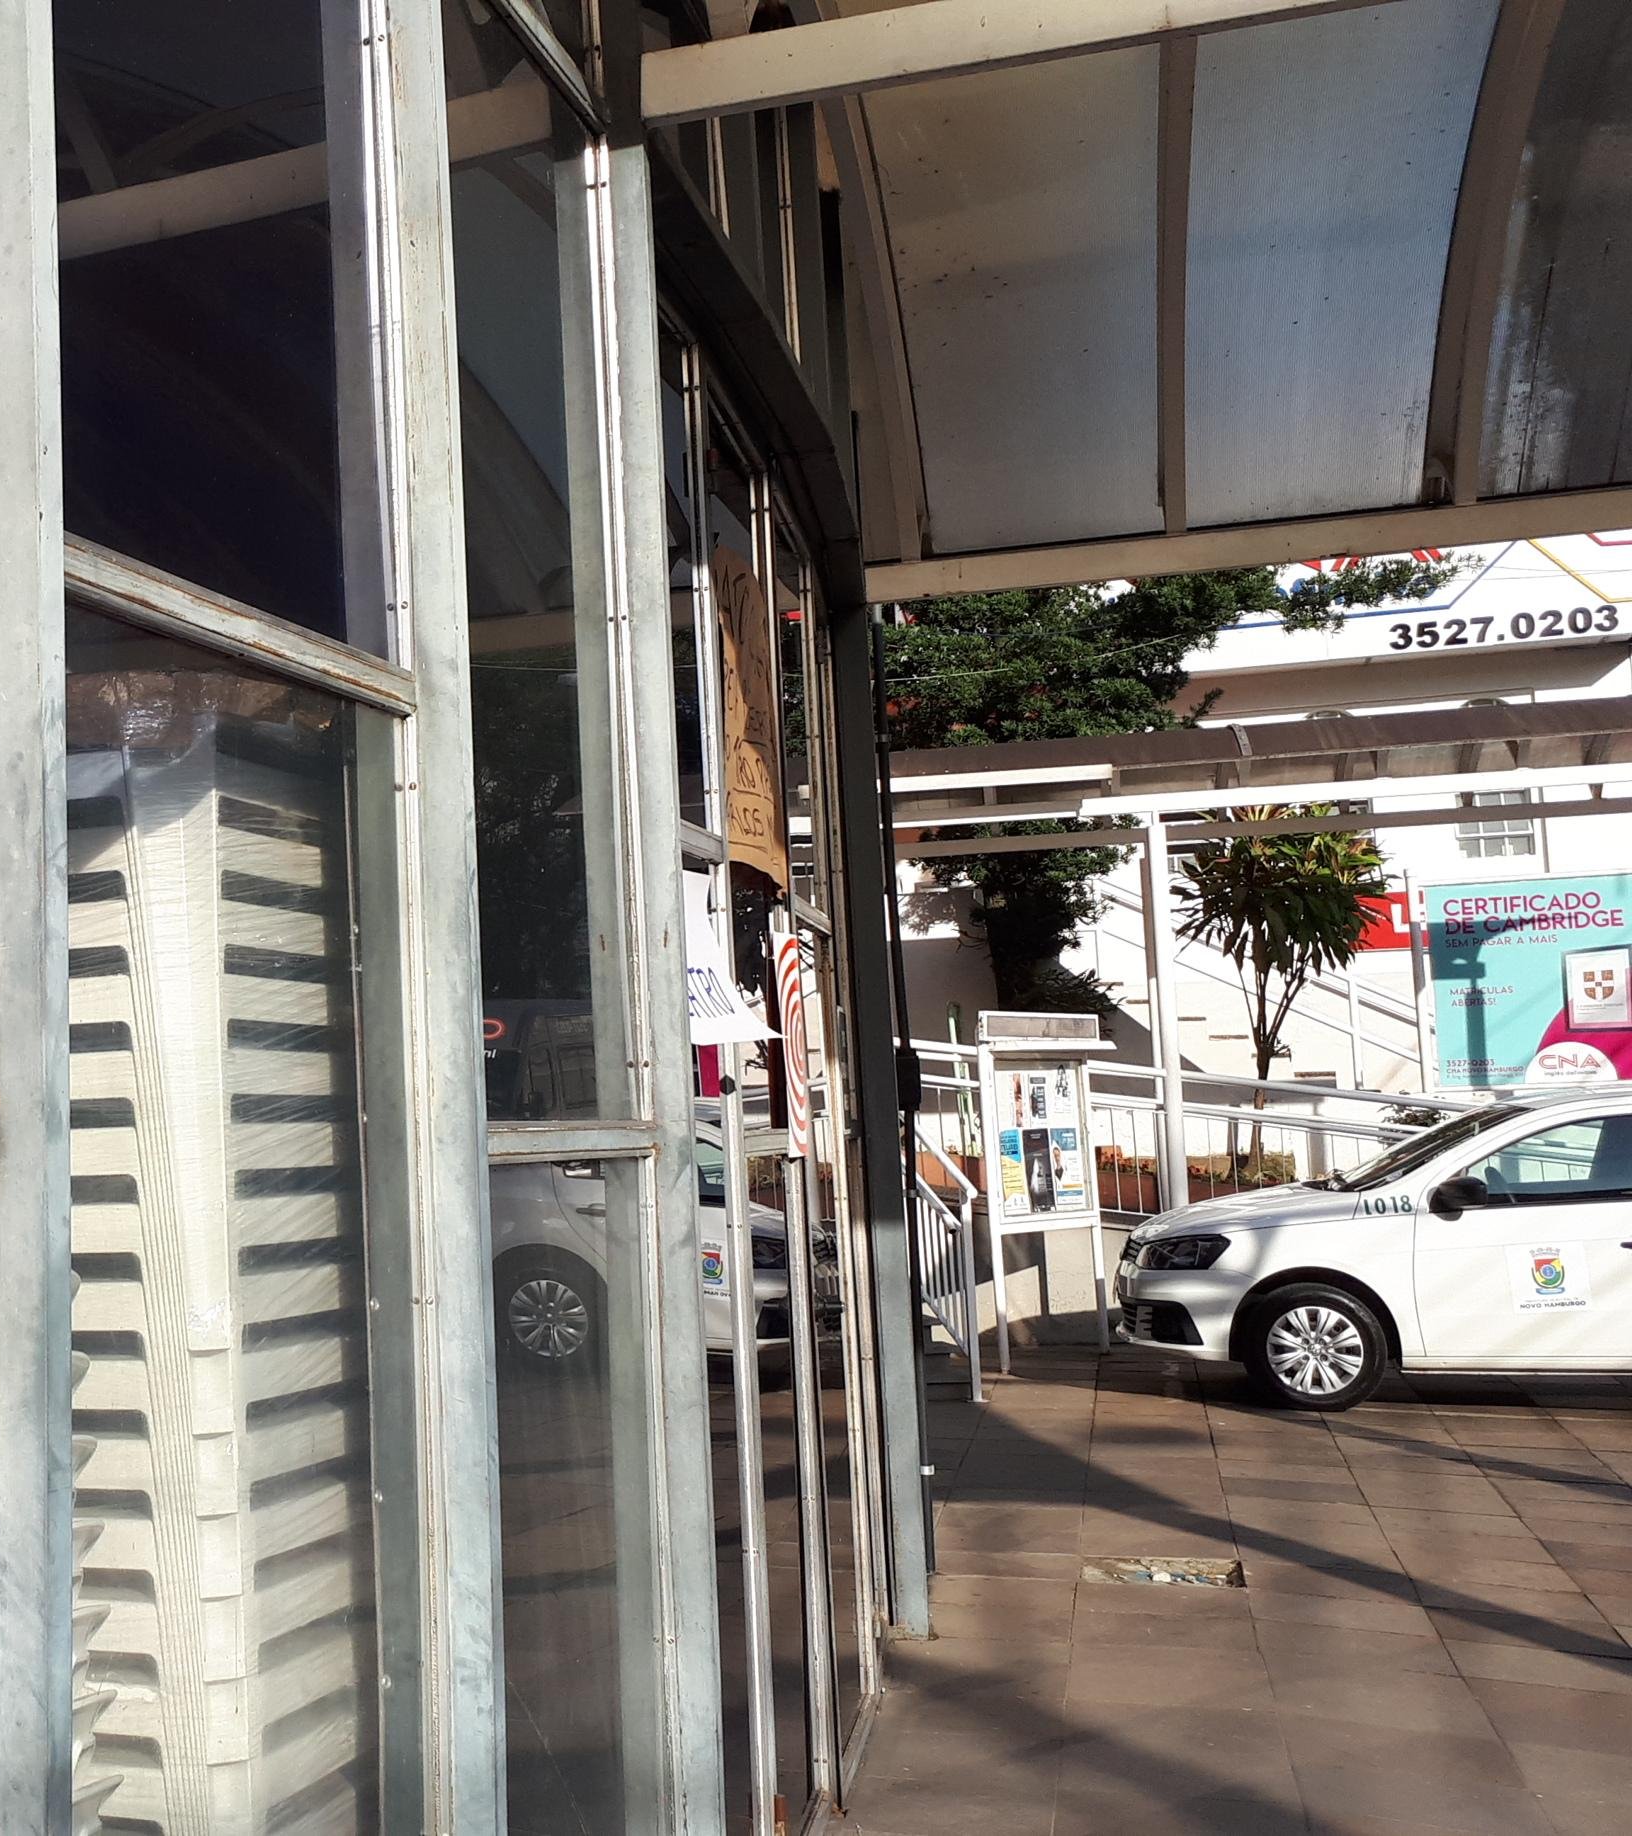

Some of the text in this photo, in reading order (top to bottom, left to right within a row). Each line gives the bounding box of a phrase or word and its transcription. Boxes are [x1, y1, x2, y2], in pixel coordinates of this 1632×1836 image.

[1389, 604, 1620, 650] 3527.0203
[1443, 892, 1601, 916] CERTIFICADO
[1445, 917, 1476, 935] DE
[1483, 909, 1624, 934] CAMBRIDGE
[1445, 934, 1558, 948] SEM PAGAR A MAIS
[687, 966, 736, 1019] ATRO
[1451, 997, 1497, 1007] ABERTAS!
[1539, 1054, 1601, 1070] CNA
[1364, 1195, 1413, 1215] 1018
